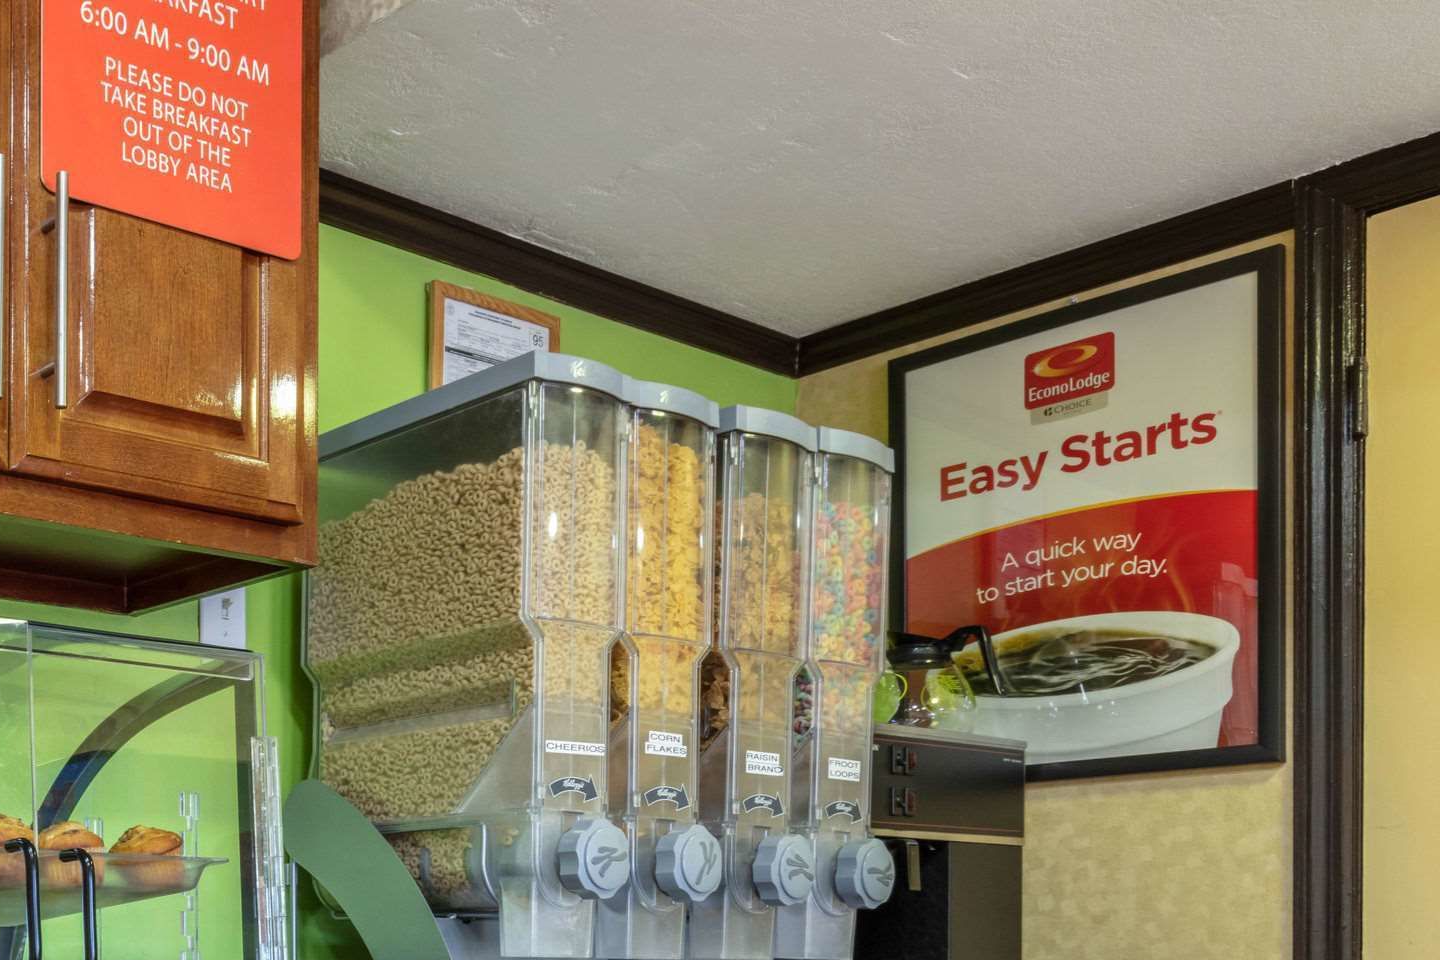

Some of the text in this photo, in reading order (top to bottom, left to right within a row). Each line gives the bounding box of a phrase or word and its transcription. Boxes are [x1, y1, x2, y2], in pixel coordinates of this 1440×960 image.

[80, 1, 127, 35] 6:00
[134, 19, 170, 51] AM
[187, 37, 231, 72] 9:00
[236, 55, 270, 86] AM
[105, 56, 248, 121] PLEASE DO NOT
[100, 80, 251, 148] TAKE BREAKFAST
[123, 116, 231, 167] OUT OF THE
[122, 141, 232, 193] LOBBY AREA
[940, 412, 1217, 502] Easy Starts
[1001, 532, 1142, 572] A quick way
[976, 555, 1168, 604] to start your day.
[546, 742, 606, 753] CHEERIOS
[646, 744, 688, 756] FLAKES
[650, 733, 681, 743] CORN
[746, 752, 778, 762] RAISIN
[830, 760, 859, 769] FROOT
[830, 770, 860, 779] LOOPS
